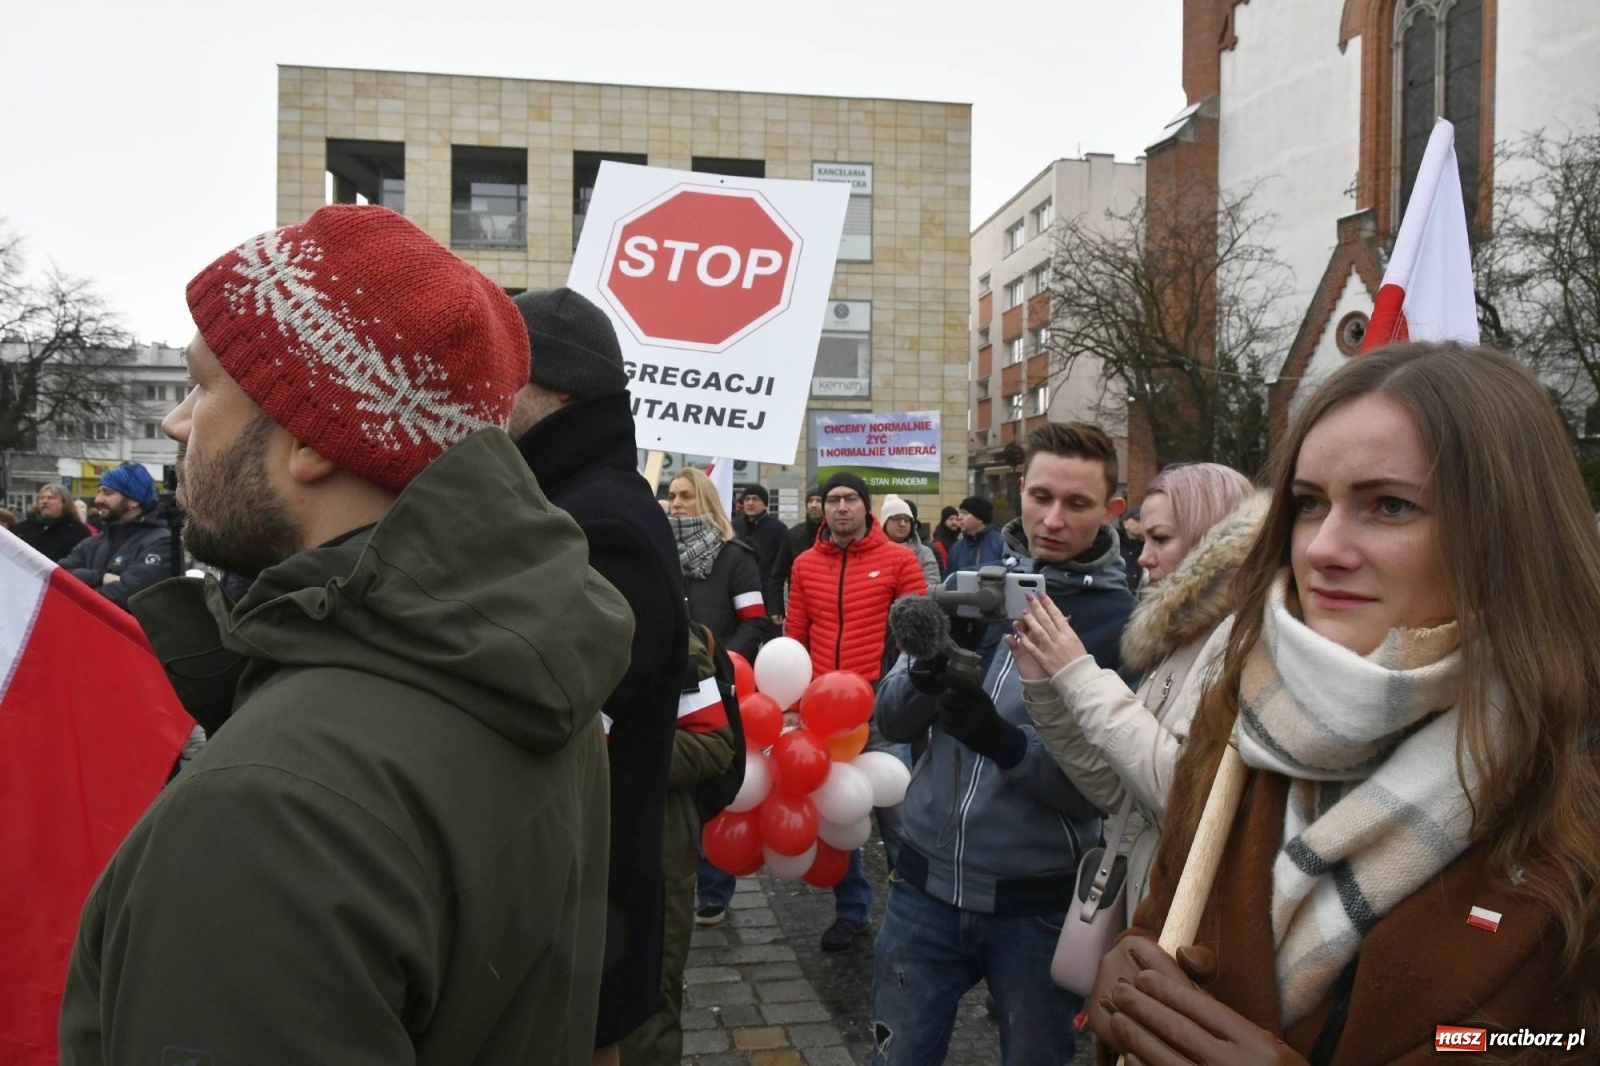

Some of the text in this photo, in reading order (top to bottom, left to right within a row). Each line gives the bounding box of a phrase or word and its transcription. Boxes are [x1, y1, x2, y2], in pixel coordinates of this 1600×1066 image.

[818, 168, 866, 177] KANCELARIA
[618, 235, 783, 289] STOP
[624, 361, 775, 396] GREGACJI
[633, 397, 766, 430] ITARNEJ
[824, 421, 932, 434] CHCEMY NORMALNIE
[866, 433, 887, 445] ŻYĆ
[820, 443, 937, 457] I NORMALNIE UMIERAĆ
[870, 477, 889, 486] STAN
[892, 477, 928, 486] PANDEMII
